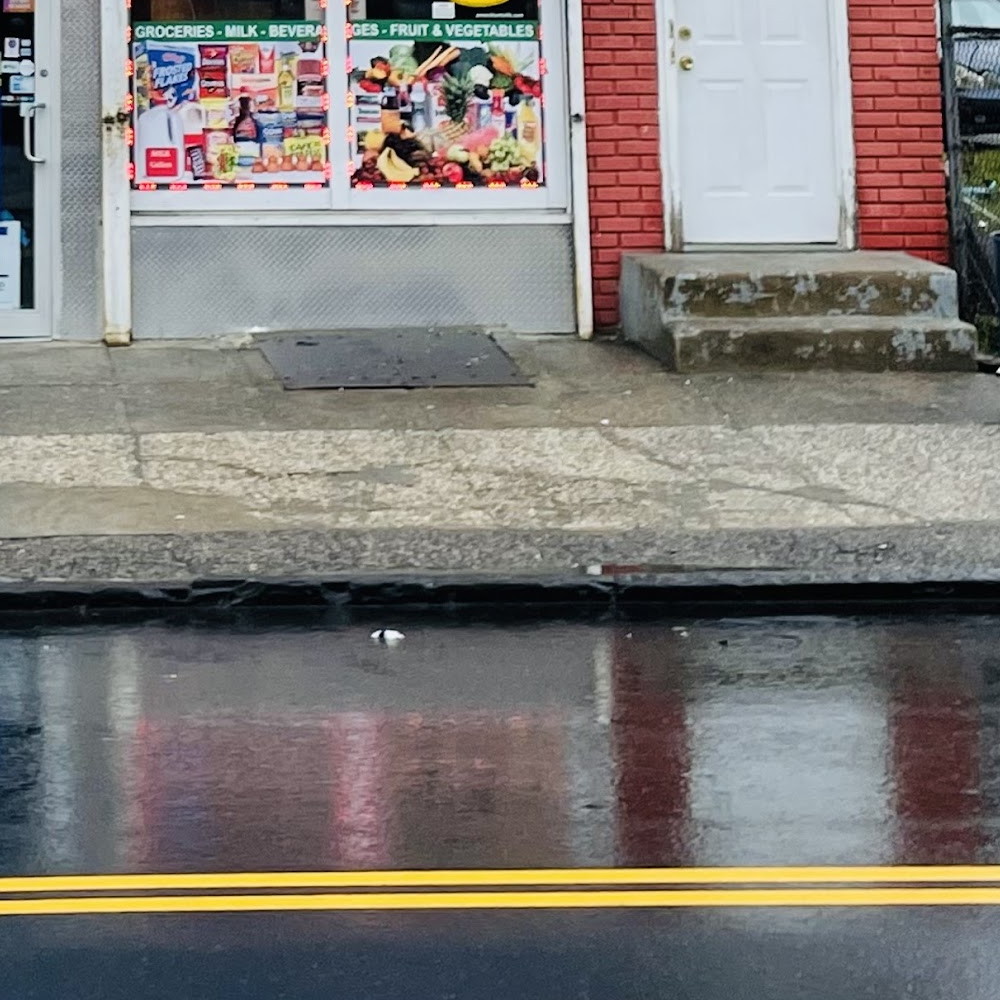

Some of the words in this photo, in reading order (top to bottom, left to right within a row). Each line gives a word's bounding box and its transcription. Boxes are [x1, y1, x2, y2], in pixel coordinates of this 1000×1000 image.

[135, 24, 214, 39] GROCERIES
[224, 24, 258, 38] MILK
[389, 23, 430, 37] FRUIT
[432, 24, 443, 37] &
[444, 23, 535, 38] VEGETABLES
